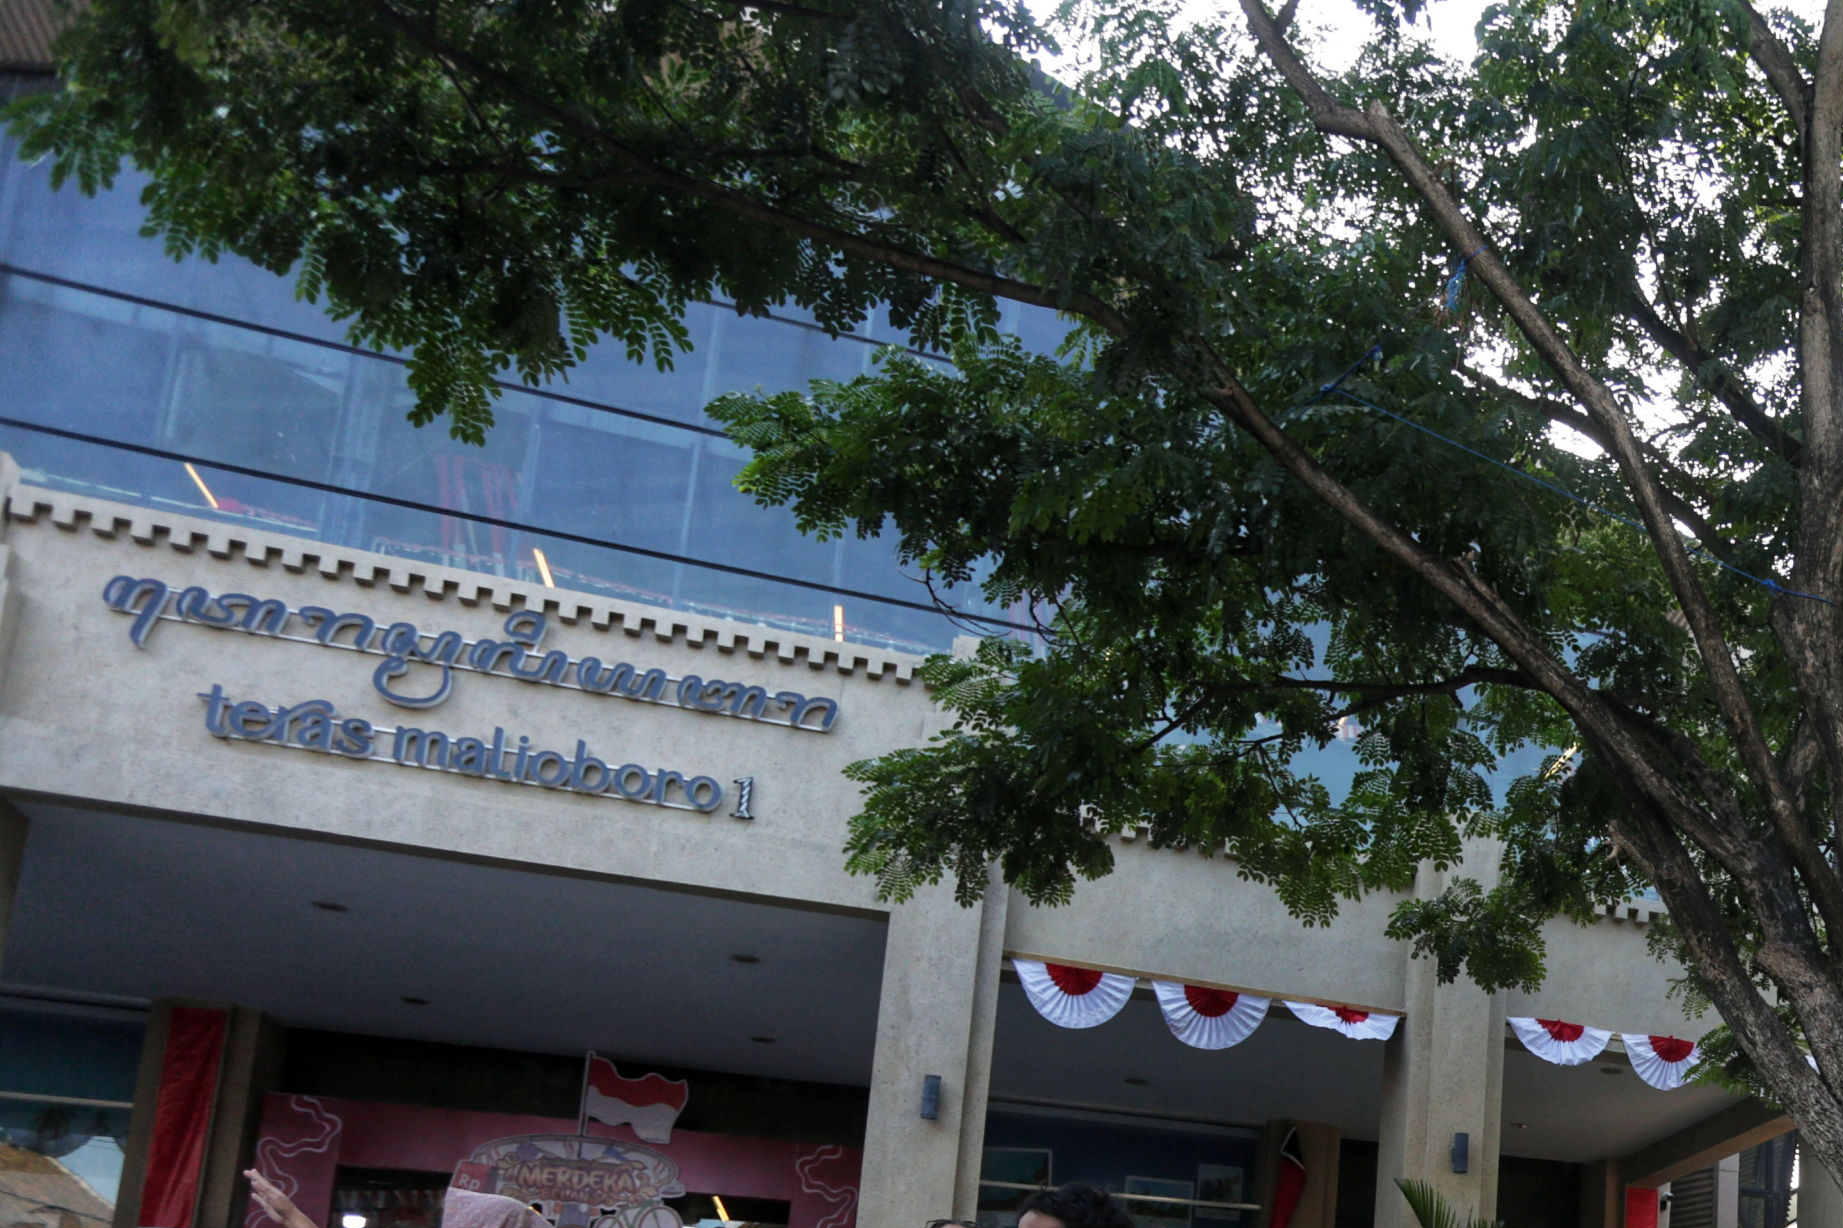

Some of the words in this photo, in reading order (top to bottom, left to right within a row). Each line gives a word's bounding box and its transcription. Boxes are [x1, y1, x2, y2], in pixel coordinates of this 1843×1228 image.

[197, 683, 376, 760] teras
[393, 725, 724, 813] malioboro
[517, 1164, 634, 1190] MERDEKA
